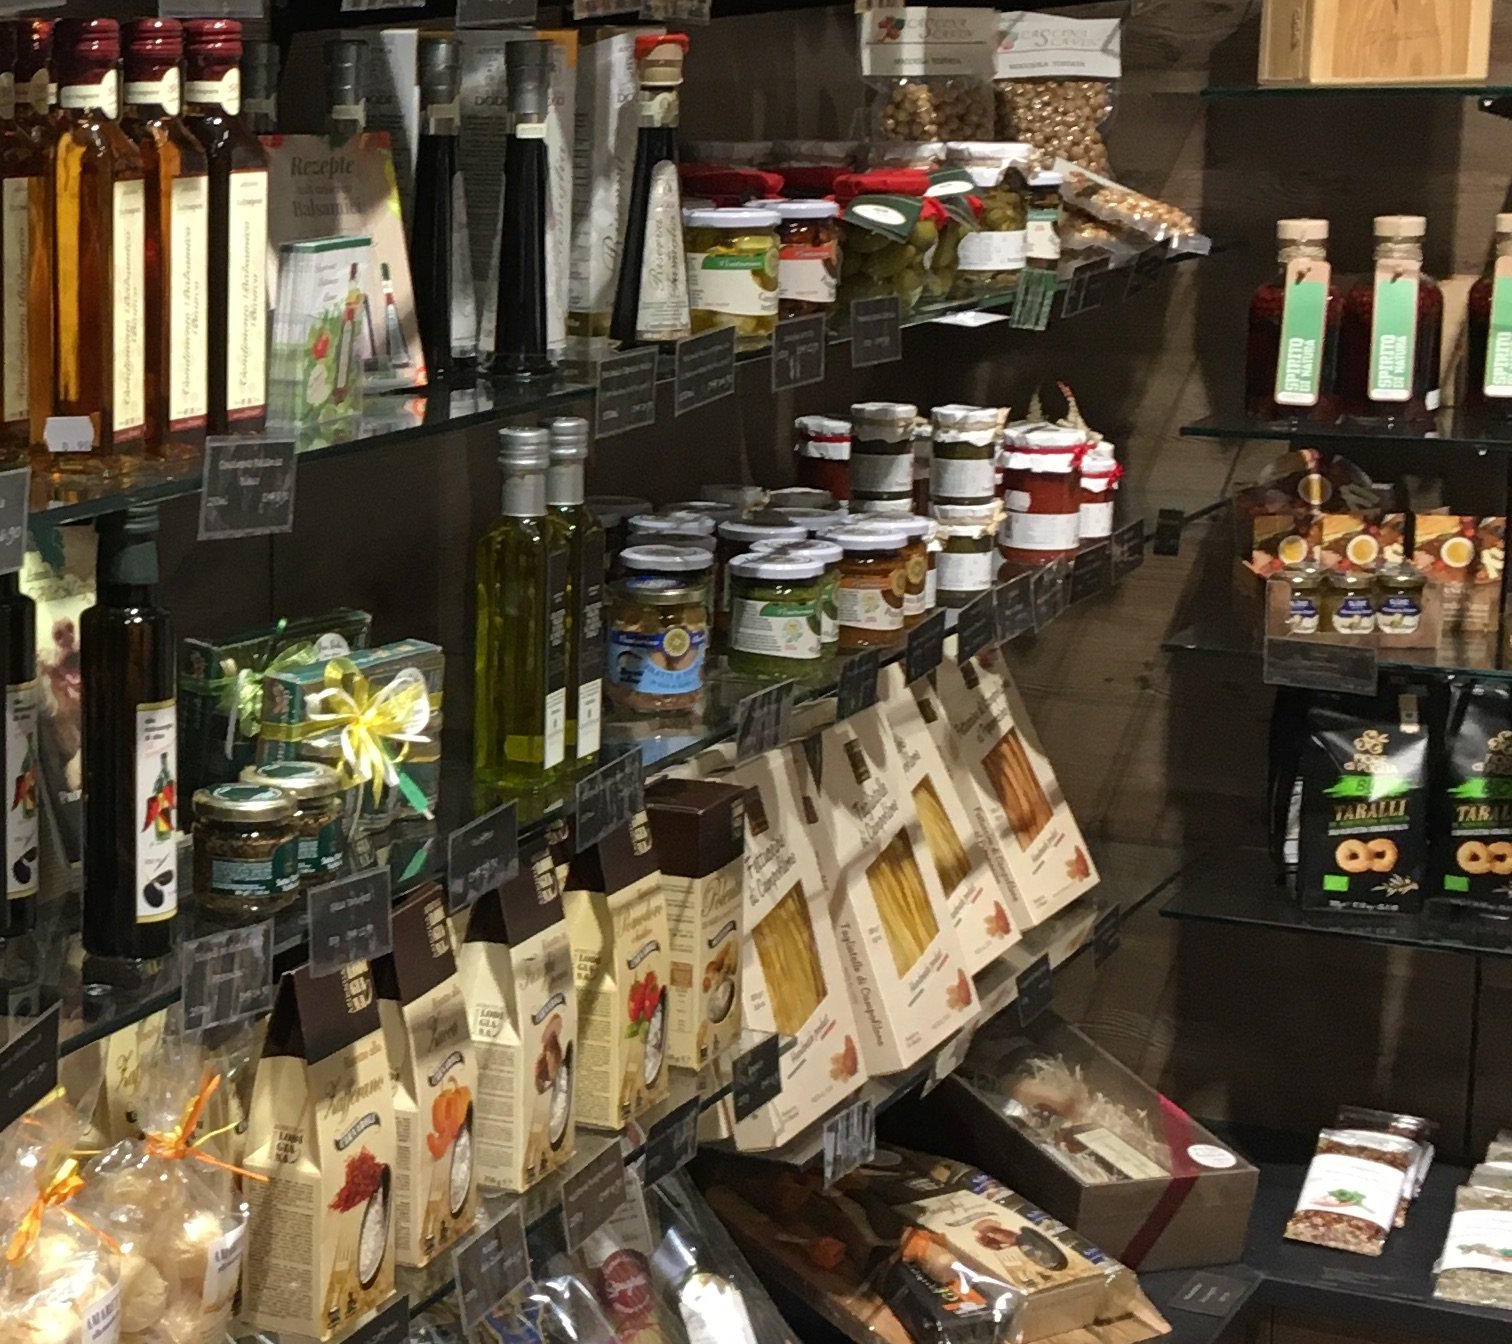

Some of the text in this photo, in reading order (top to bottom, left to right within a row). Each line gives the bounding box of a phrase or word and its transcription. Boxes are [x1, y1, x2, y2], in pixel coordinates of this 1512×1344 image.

[290, 156, 355, 179] Rezepte
[1284, 337, 1305, 392] SPIRITO
[1377, 334, 1396, 388] SPIRITO
[1334, 799, 1408, 821] TARALLI
